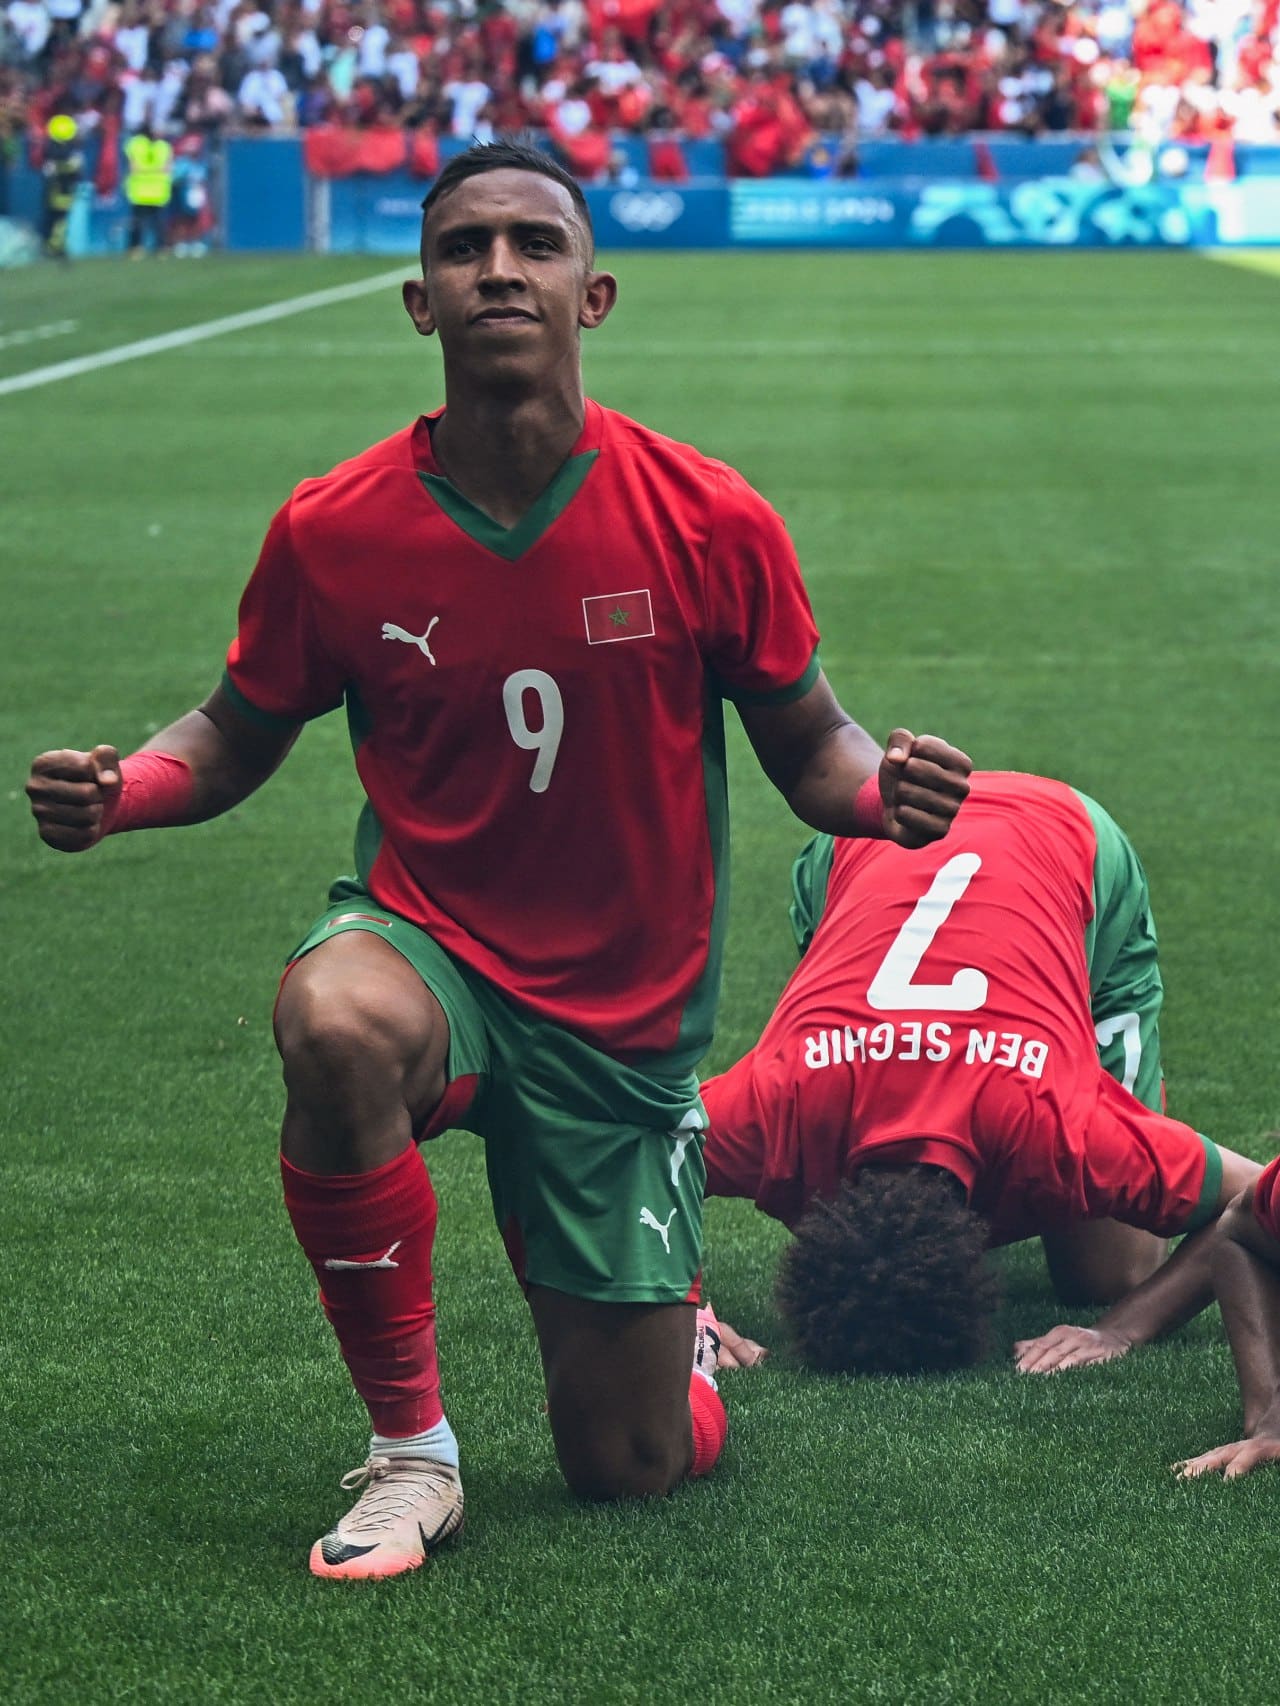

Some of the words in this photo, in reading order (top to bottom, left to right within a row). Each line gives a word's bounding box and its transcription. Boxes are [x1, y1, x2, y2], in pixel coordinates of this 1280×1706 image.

[503, 669, 564, 793] 9
[866, 852, 989, 1011] 7
[804, 1021, 952, 1069] SEGHIR
[965, 1028, 1050, 1079] BEN
[1094, 1012, 1142, 1095] 7
